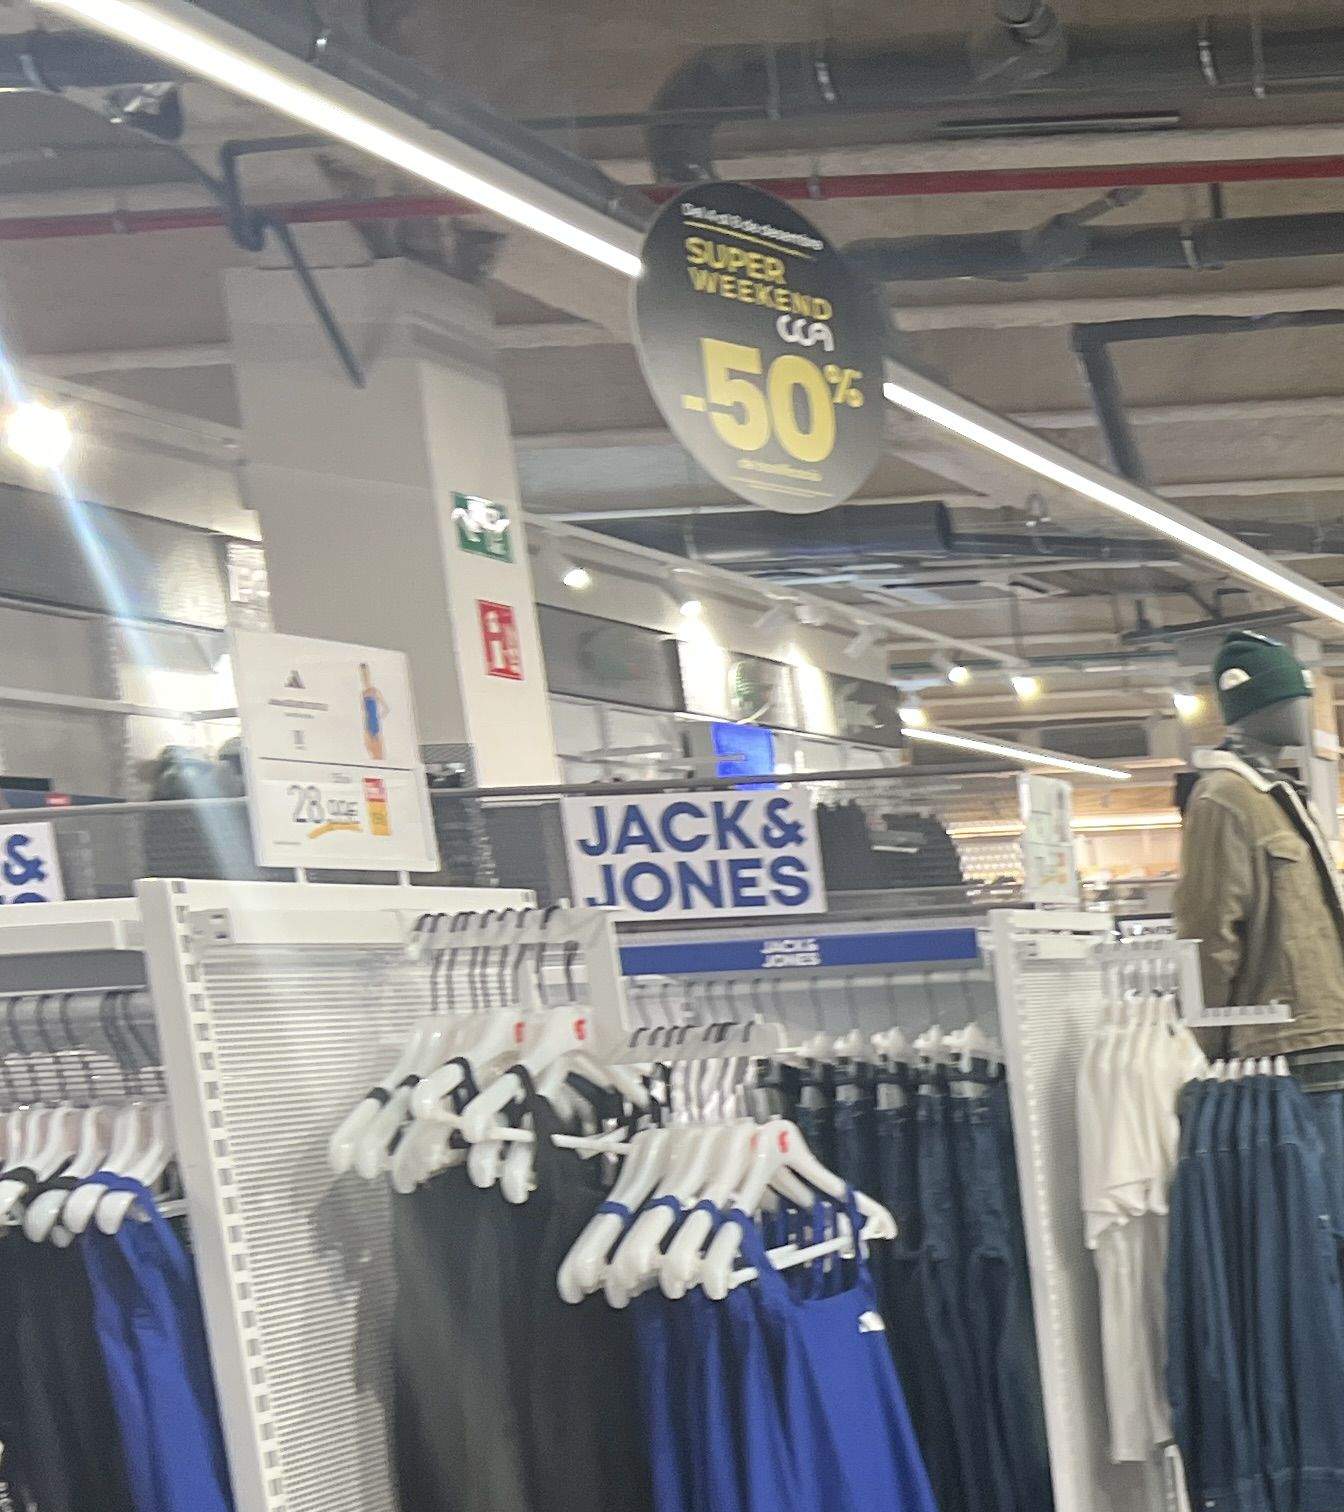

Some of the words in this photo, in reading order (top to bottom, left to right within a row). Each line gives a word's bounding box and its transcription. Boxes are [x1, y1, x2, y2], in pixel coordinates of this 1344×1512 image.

[684, 236, 787, 284] SUPER
[687, 267, 833, 321] WEEKEND
[681, 338, 864, 462] -50%
[584, 856, 811, 912] JONES
